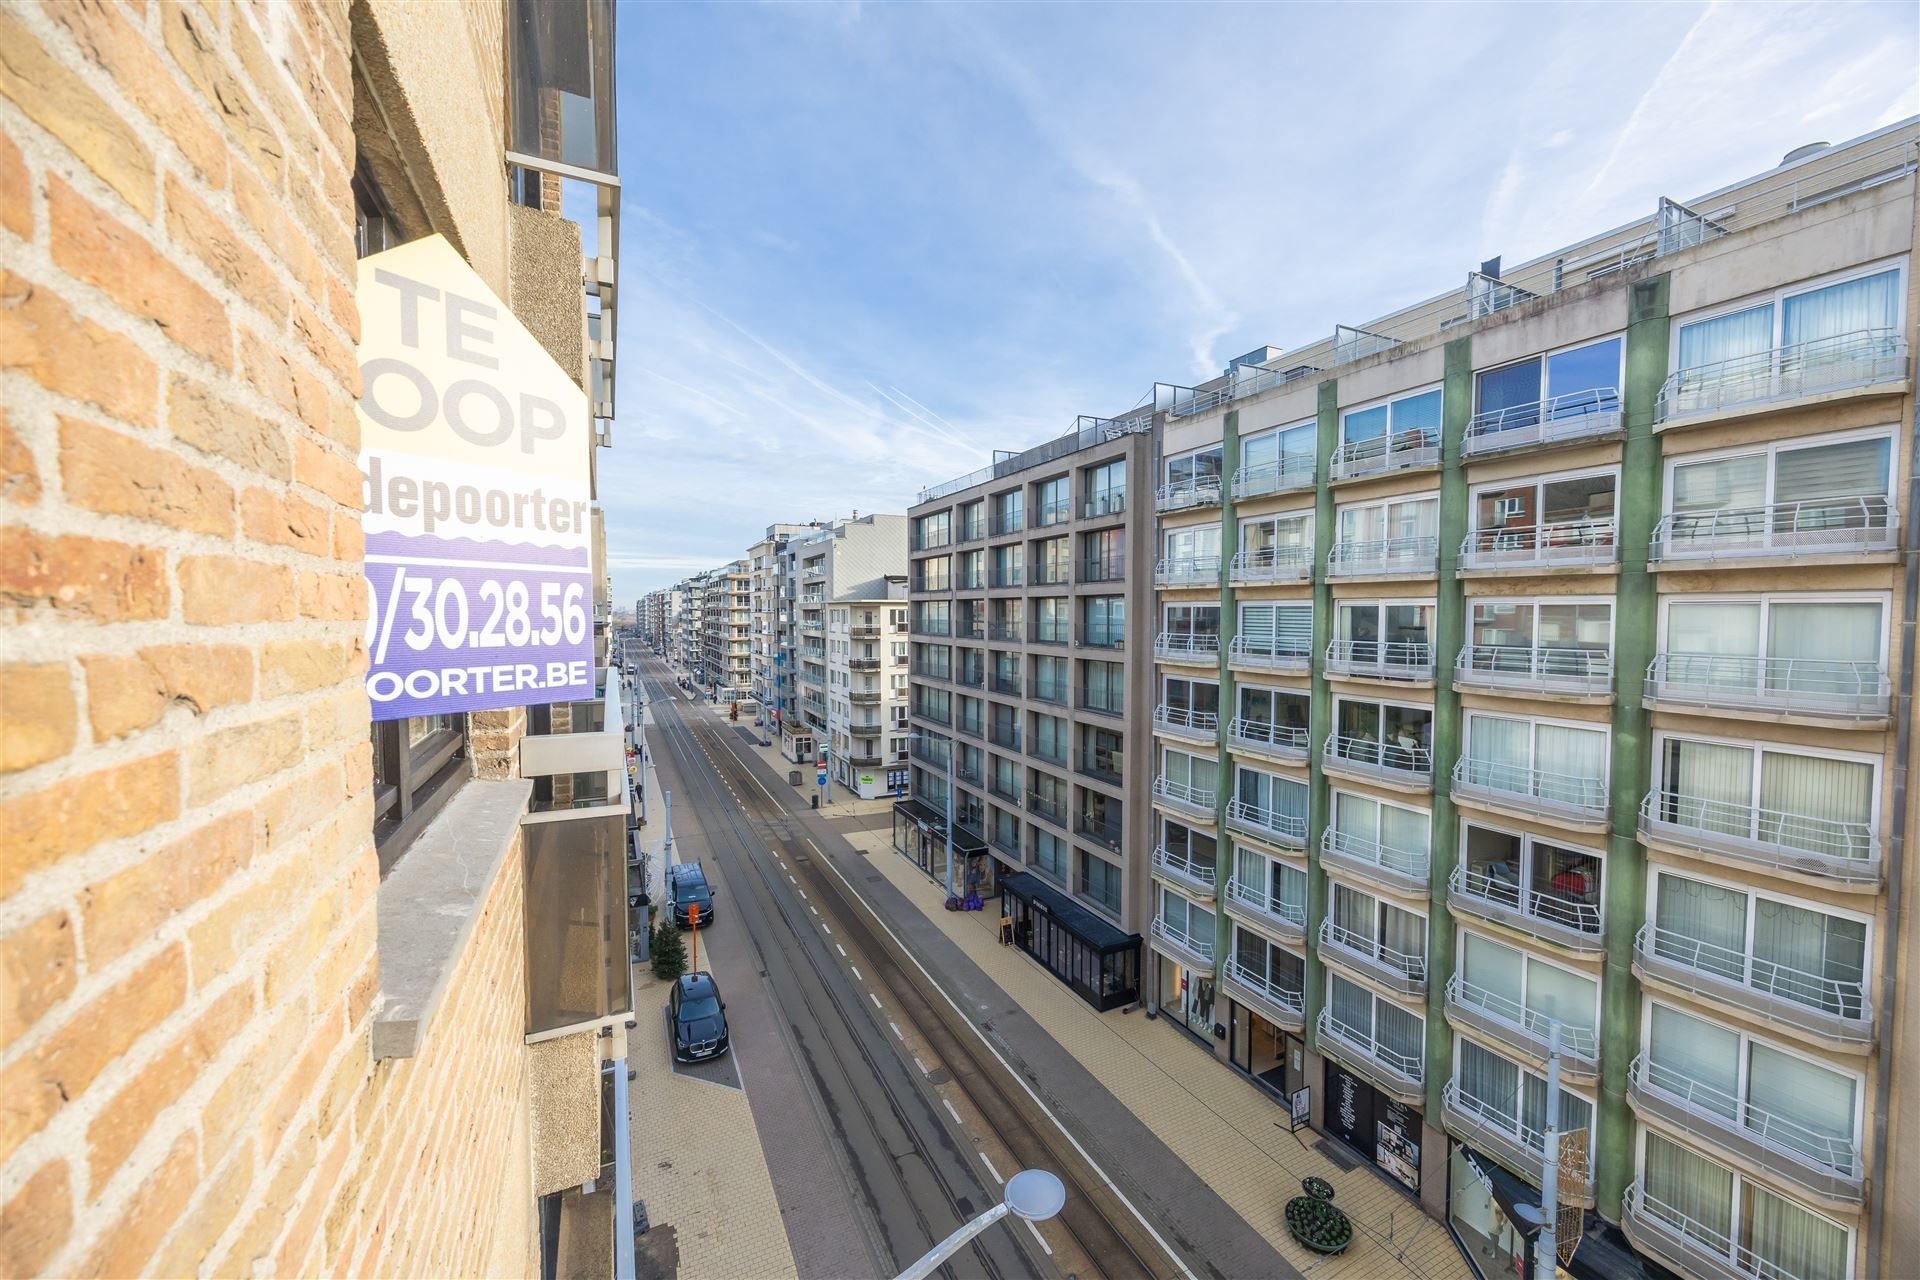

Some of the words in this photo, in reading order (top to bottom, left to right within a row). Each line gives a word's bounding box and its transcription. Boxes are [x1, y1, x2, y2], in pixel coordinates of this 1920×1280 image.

[375, 267, 499, 371] TE
[358, 358, 567, 455] OOP
[361, 456, 587, 534] depoorter
[364, 660, 588, 702] OORTER.BE
